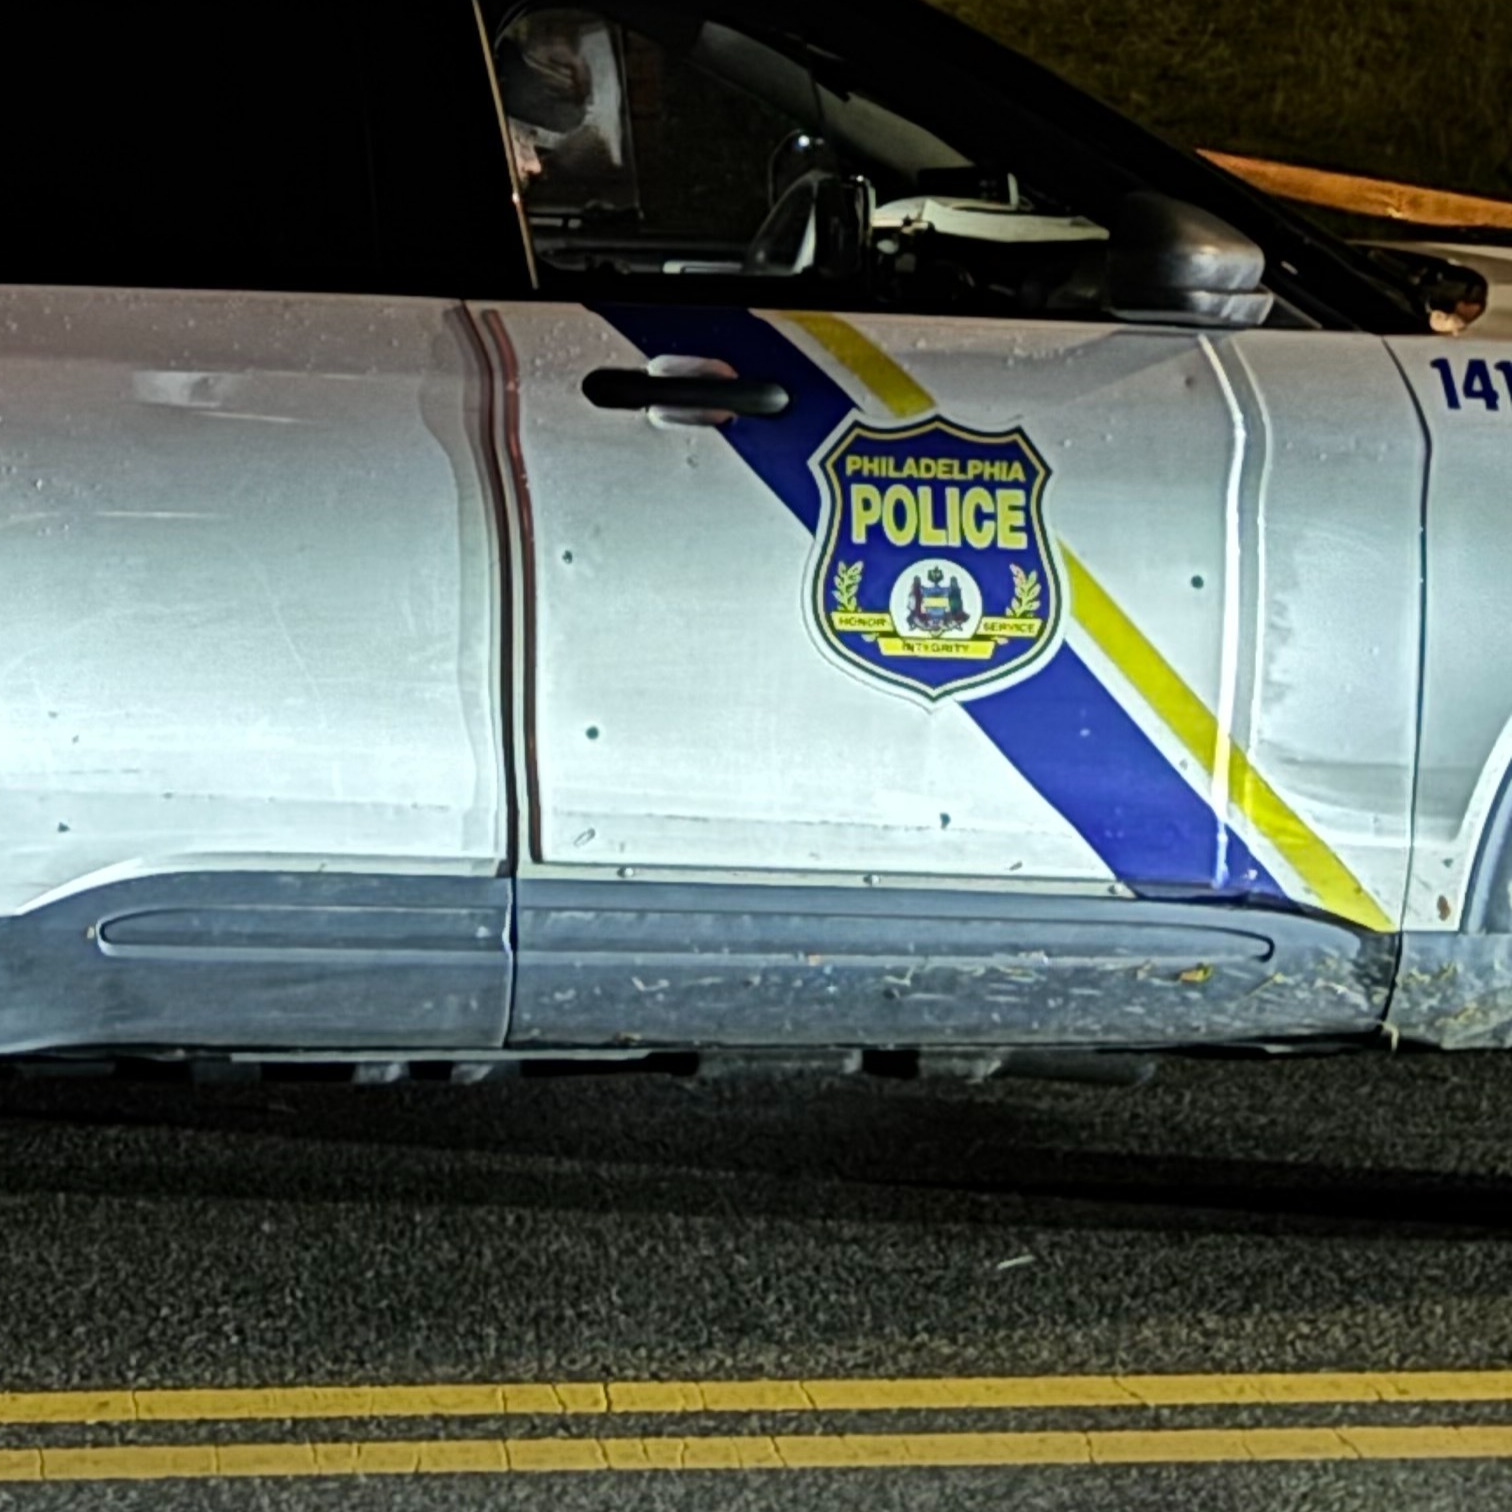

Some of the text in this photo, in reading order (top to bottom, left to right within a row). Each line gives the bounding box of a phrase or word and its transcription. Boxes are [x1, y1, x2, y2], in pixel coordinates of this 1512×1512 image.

[845, 455, 1026, 482] PHILADELPHIA
[850, 484, 1029, 550] POLICE
[839, 617, 887, 627] HONOR
[983, 622, 1035, 633] SERVICE
